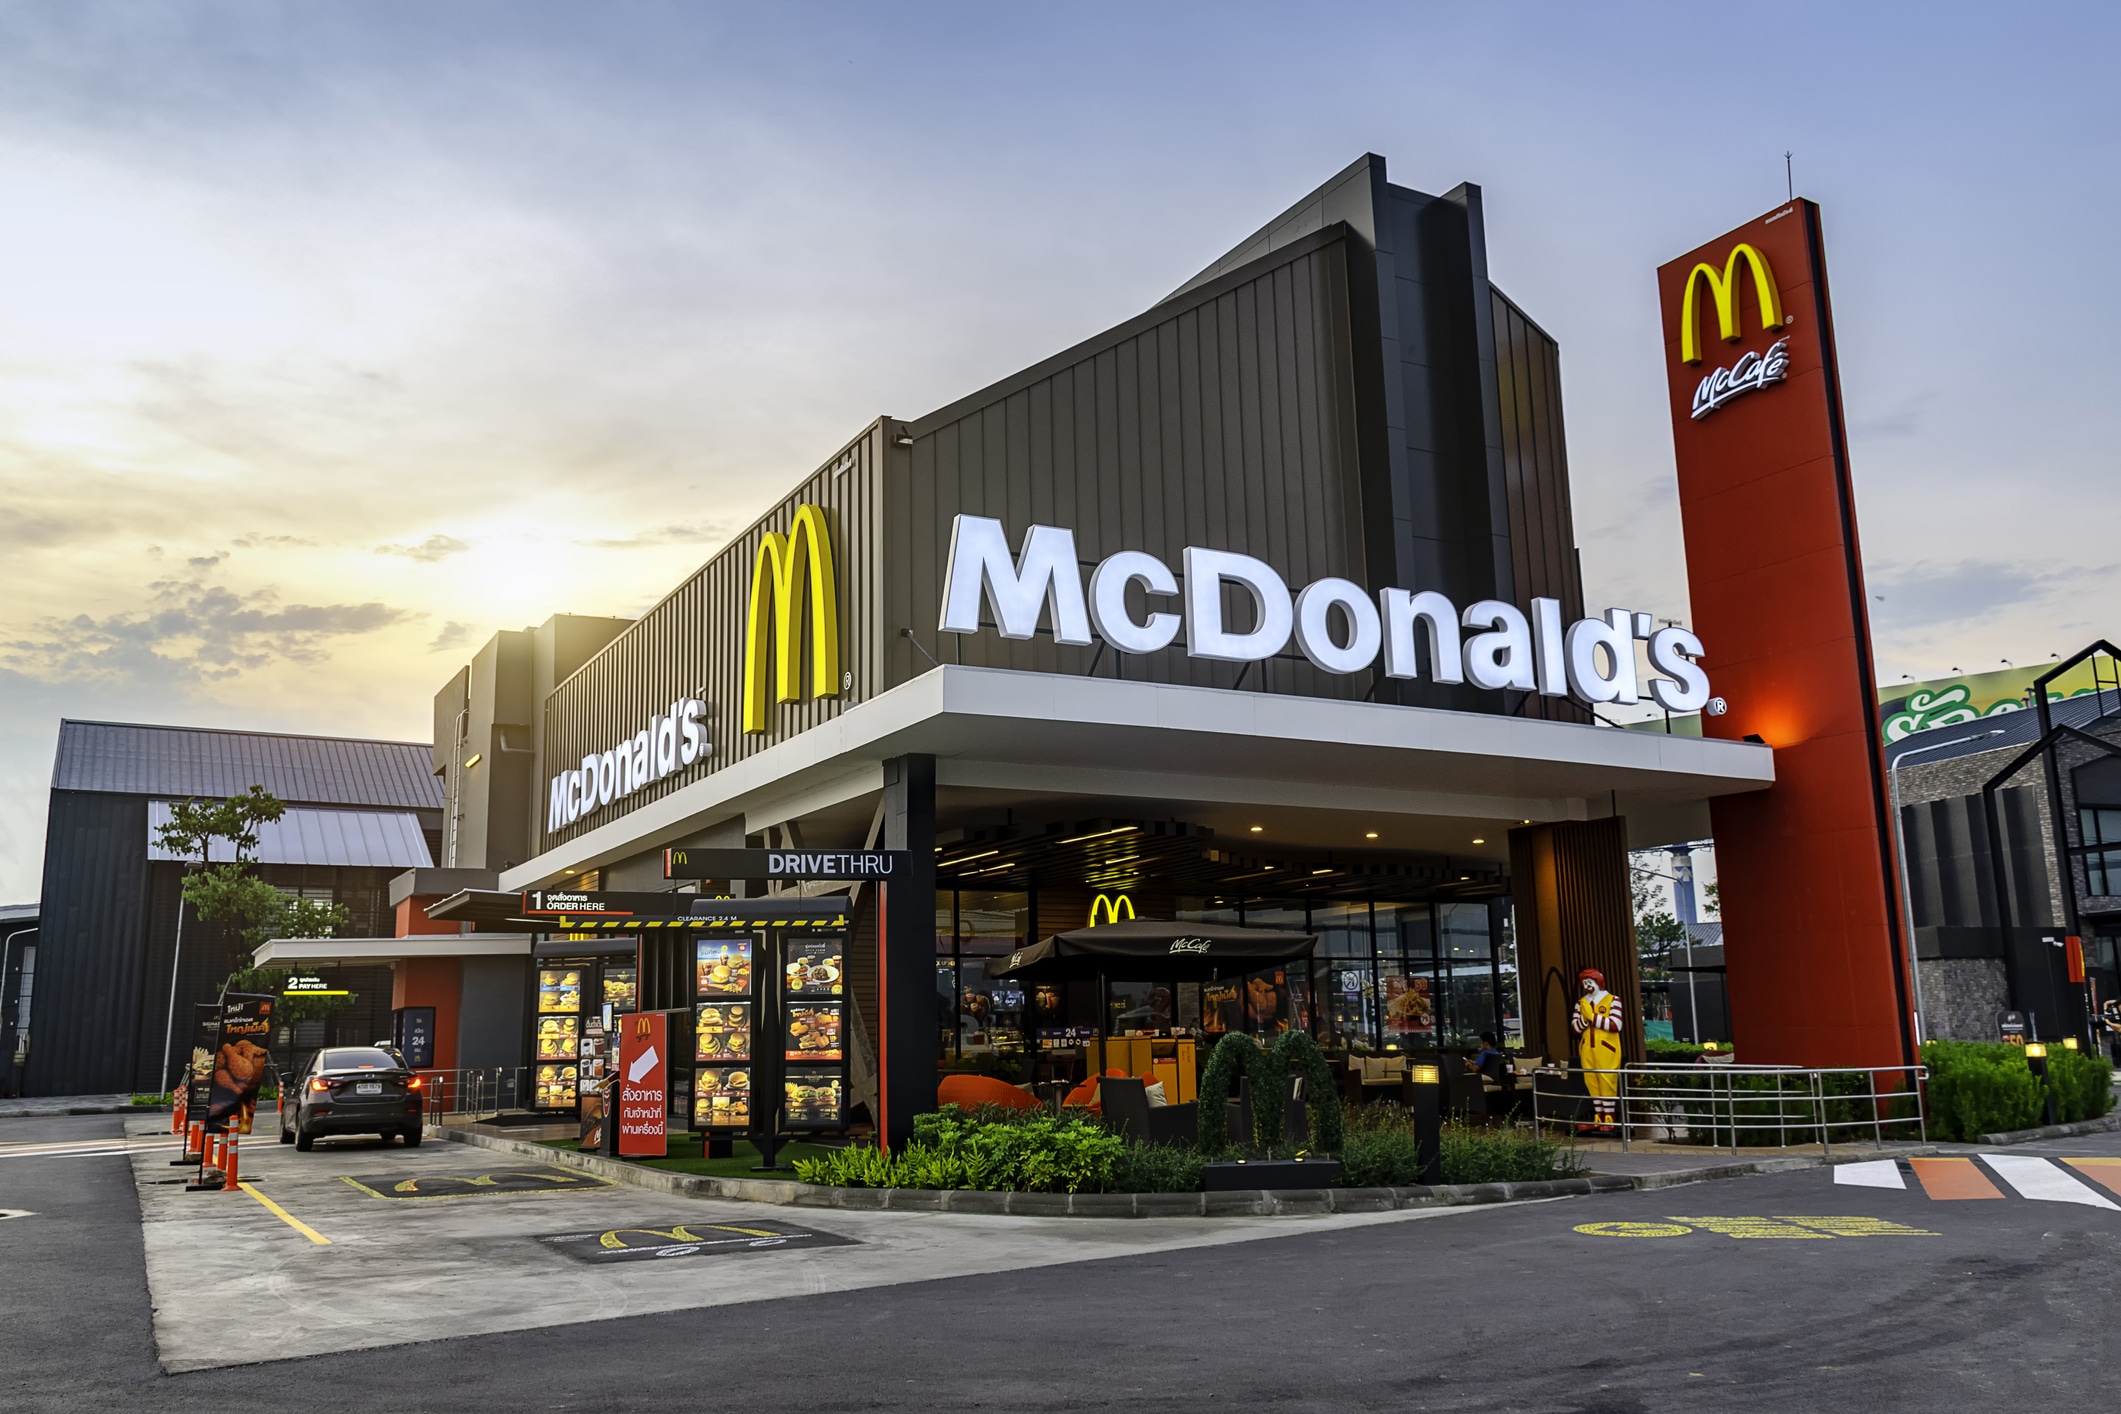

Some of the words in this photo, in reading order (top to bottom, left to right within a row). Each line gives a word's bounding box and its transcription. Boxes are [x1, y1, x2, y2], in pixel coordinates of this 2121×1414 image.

[938, 513, 1711, 714] McDonald's
[548, 697, 708, 834] McDonald's
[532, 891, 542, 910] 1
[546, 902, 579, 910] ORDER
[580, 903, 605, 911] HERE
[288, 977, 298, 990] 2
[1065, 1028, 1077, 1037] 24
[412, 1036, 425, 1046] 24
[622, 1084, 663, 1101] สั่งอาหาร
